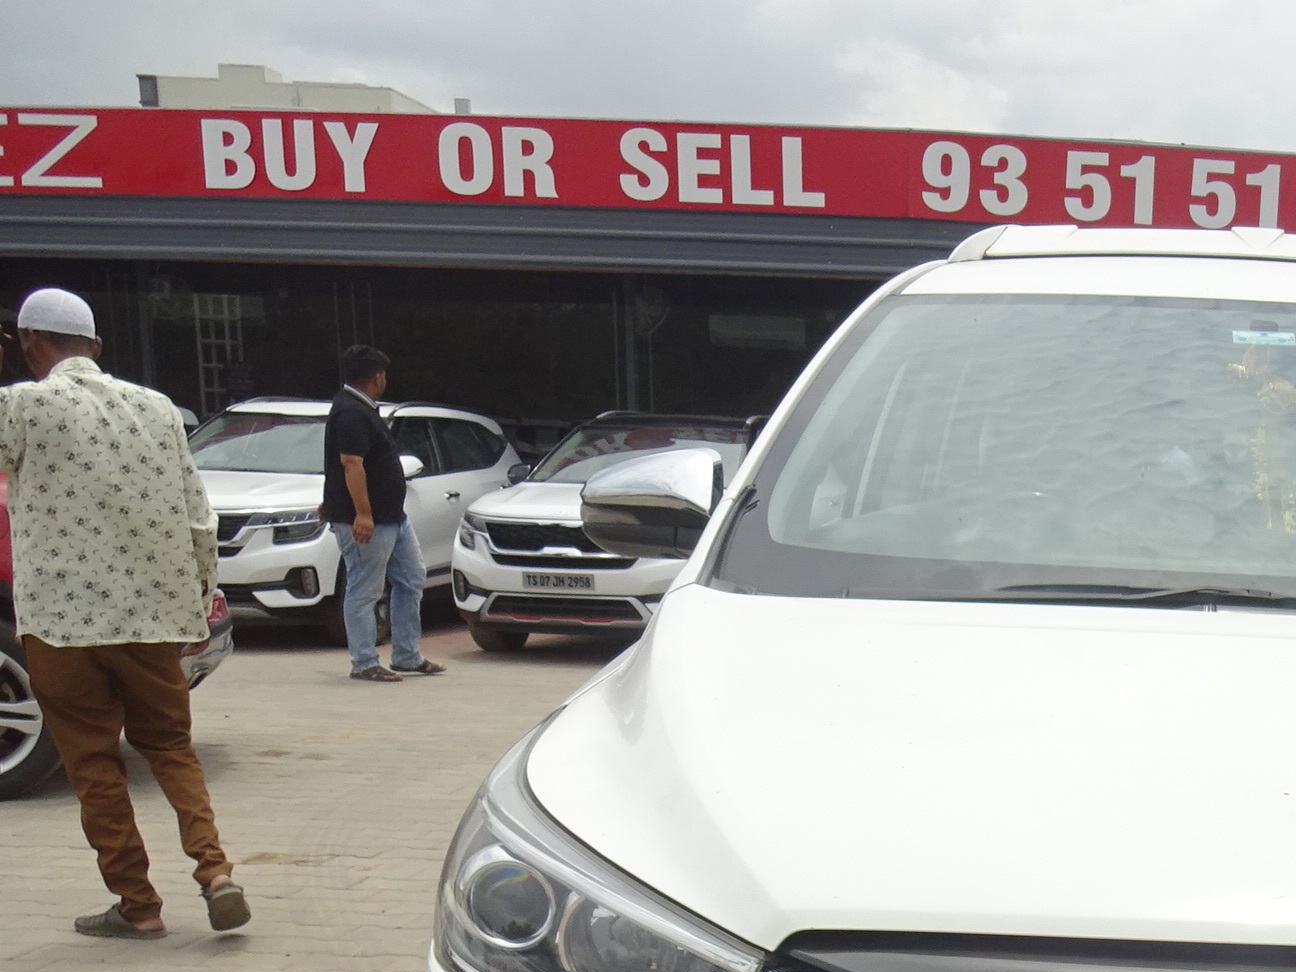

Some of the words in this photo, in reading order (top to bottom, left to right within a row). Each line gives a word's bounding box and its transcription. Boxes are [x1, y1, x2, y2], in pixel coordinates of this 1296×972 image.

[0, 113, 104, 188] Z
[200, 118, 380, 193] BUY
[438, 122, 559, 199] OR
[619, 128, 826, 208] SELL
[921, 140, 1030, 216] 93
[1063, 150, 1157, 226] 51
[1189, 158, 1283, 230] 51
[526, 574, 538, 587] TS
[540, 575, 551, 587] 07
